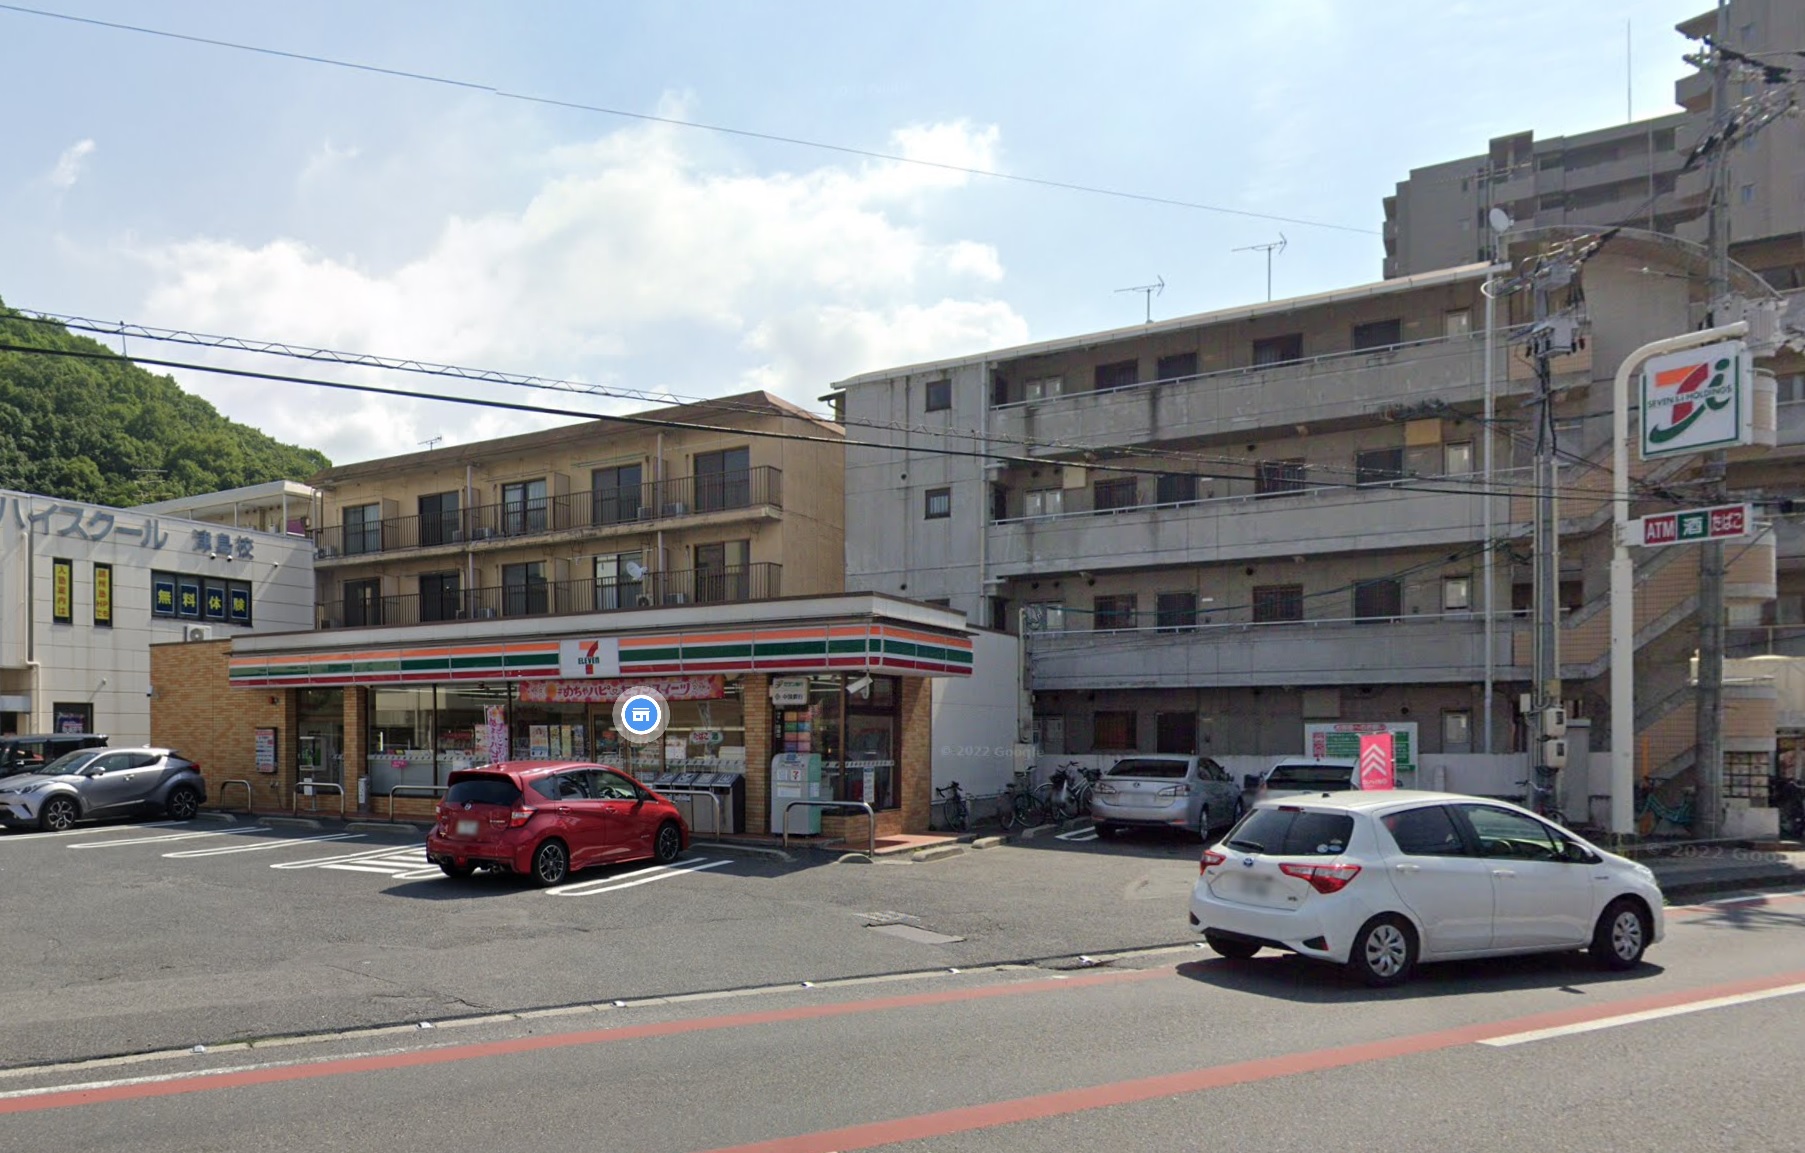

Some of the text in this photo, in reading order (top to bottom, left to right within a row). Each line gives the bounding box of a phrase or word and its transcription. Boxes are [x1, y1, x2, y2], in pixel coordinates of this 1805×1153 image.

[1685, 385, 1733, 401] HOLDINGS
[1647, 520, 1675, 540] ATM
[1683, 516, 1704, 537] 酒
[1711, 512, 1742, 532] たばこ
[158, 589, 246, 612] 無料体験
